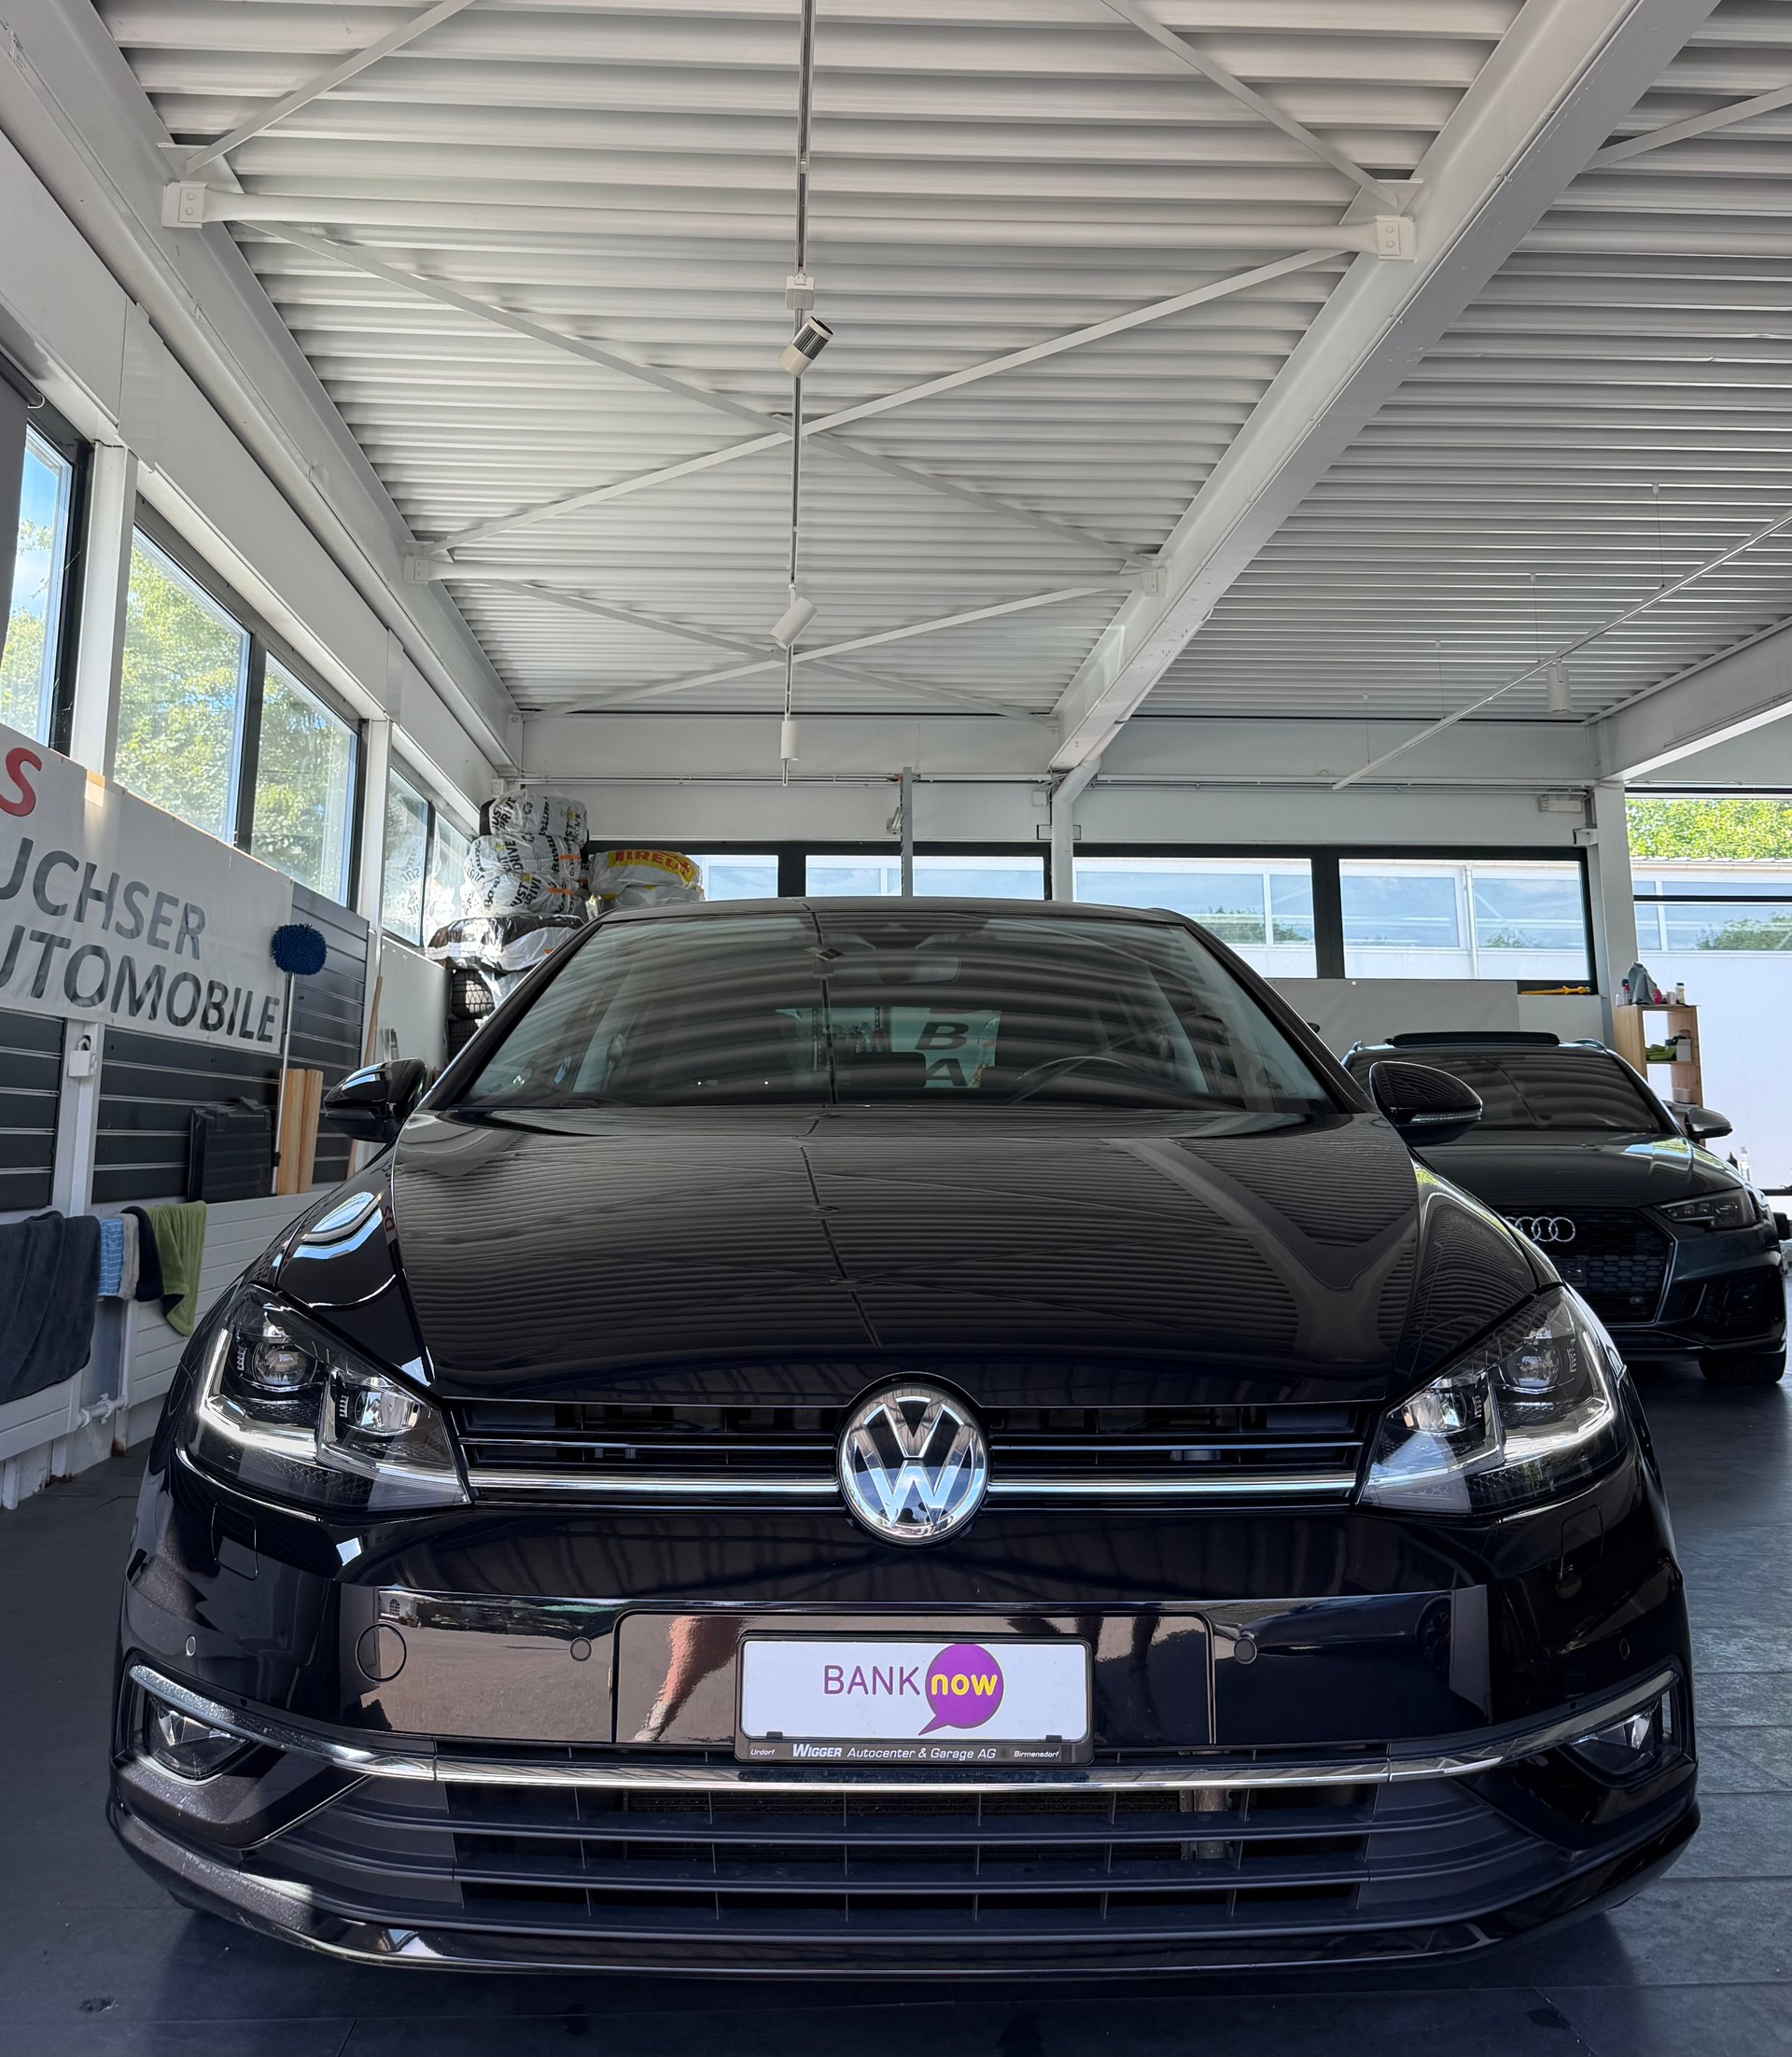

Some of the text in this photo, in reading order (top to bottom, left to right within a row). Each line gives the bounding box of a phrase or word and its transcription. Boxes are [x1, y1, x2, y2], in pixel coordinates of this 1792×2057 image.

[0, 747, 42, 818] S
[614, 850, 692, 875] PIREL
[823, 1665, 999, 1697] BANK now
[792, 1743, 997, 1761] WIGGER Autocenter & Garage AG
[1014, 1750, 1060, 1758] Birmensdorf
